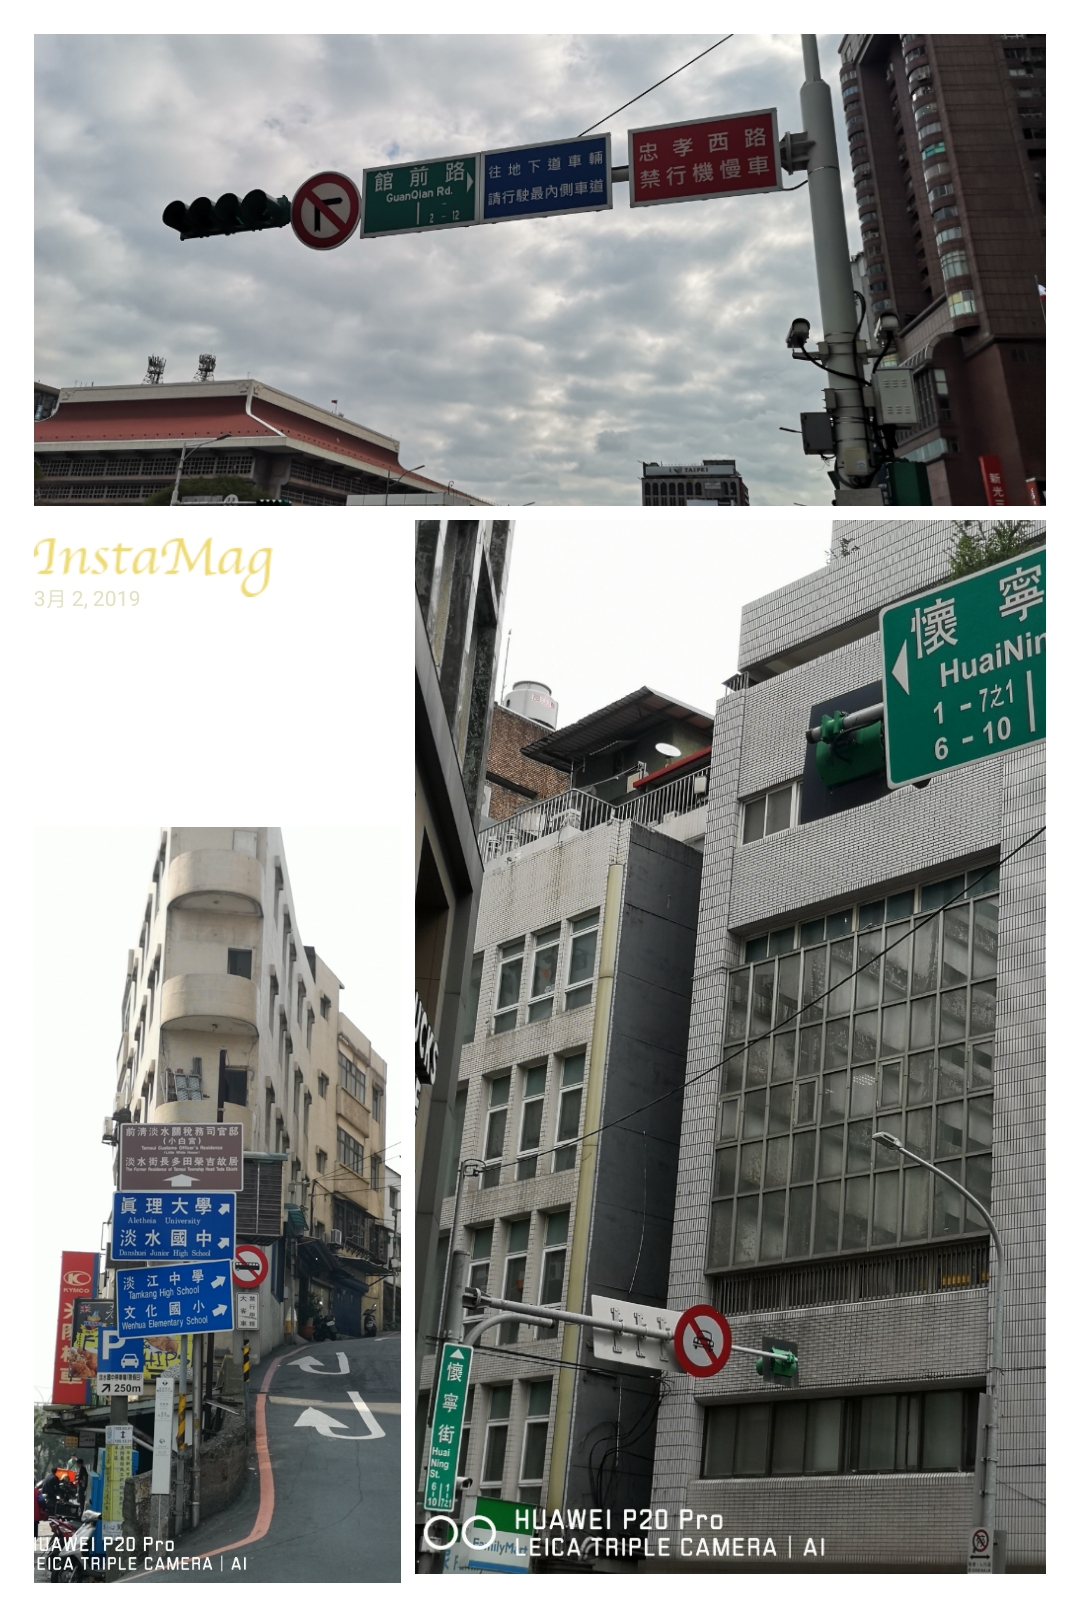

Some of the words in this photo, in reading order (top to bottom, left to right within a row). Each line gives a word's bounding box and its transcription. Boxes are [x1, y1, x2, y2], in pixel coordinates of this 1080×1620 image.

[638, 126, 767, 163] 忠孝西路
[487, 150, 604, 180] 往地下道車輛
[639, 155, 771, 190] 禁行機慢車
[374, 160, 466, 193] 館前路
[385, 189, 435, 203] GuanQian
[436, 186, 454, 197] Rd.
[487, 178, 605, 207] 請行駛最內側車道
[428, 213, 435, 224] 2
[452, 209, 460, 221] 12
[910, 566, 1045, 660] 懷寧
[932, 701, 944, 725] 1
[934, 737, 949, 760] 6
[983, 716, 1012, 745] 10
[125, 1126, 239, 1137] 前清淡水關稅務司官邸
[127, 1217, 157, 1225] Aletheia
[164, 1217, 201, 1226] University
[119, 1229, 212, 1248] 淡水國中
[150, 1249, 170, 1257] Junior
[173, 1249, 189, 1258] High
[191, 1249, 211, 1257] School
[123, 1268, 204, 1290] 淡江中學
[128, 1290, 158, 1300] Tamkang
[160, 1288, 175, 1299] High
[176, 1285, 200, 1296] School
[124, 1300, 206, 1320] 文化國小
[121, 1322, 147, 1331] Wenhua
[148, 1318, 184, 1329] Elementary
[186, 1315, 209, 1326] School
[114, 1383, 141, 1393] 250m
[437, 1361, 464, 1444] 懷寧街
[431, 1446, 451, 1457] Huai
[430, 1458, 450, 1471] Ning
[429, 1469, 441, 1479] St.
[431, 1482, 438, 1491] 6
[427, 1497, 438, 1507] 10
